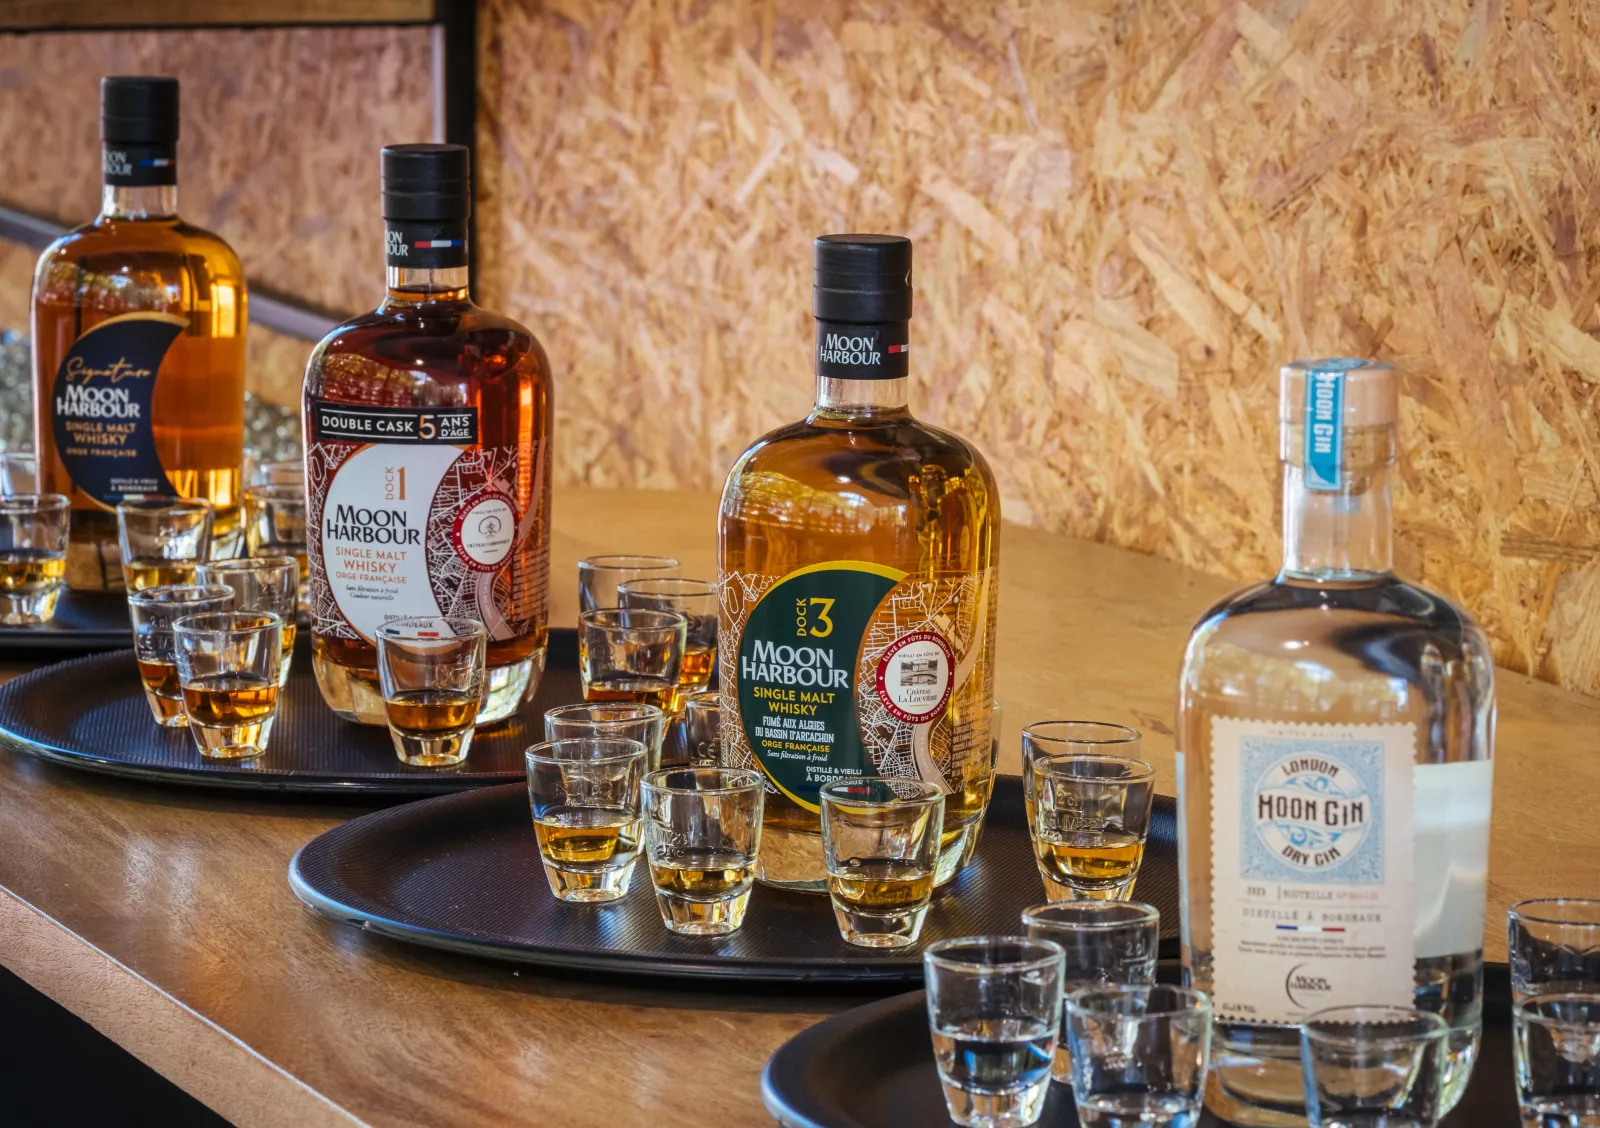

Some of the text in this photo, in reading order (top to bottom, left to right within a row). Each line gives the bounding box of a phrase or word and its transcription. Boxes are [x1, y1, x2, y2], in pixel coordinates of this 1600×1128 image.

[825, 333, 874, 352] MOON
[820, 345, 881, 365] HARBOUR
[66, 356, 152, 385] Signature
[66, 384, 129, 403] MOON
[57, 397, 141, 418] HARBOUR
[1313, 372, 1335, 454] MOON GIN
[65, 421, 137, 433] SINGLE MALT
[322, 415, 437, 440] DOUBLE CASK 5
[441, 417, 470, 427] ANS
[73, 433, 127, 446] WHISKY
[385, 466, 406, 500] DOCK 1
[336, 504, 407, 527] MOON
[327, 519, 421, 545] HARBOUR
[335, 547, 407, 560] SINGLE MALT
[343, 559, 397, 573] WHISKY
[336, 571, 407, 584] ORGE FRANÇAISE
[796, 597, 836, 638] DOCK 3
[752, 639, 834, 668] MOON
[883, 645, 898, 662] ÉLEVÉ
[907, 635, 922, 643] FÛTS
[742, 655, 849, 688] HARBOUR
[753, 687, 835, 704] SINGLE MALT
[768, 701, 817, 716] WHISKY
[880, 690, 894, 710] ÉLEVÉ
[893, 709, 902, 717] EN
[903, 713, 919, 722] FÛTS
[763, 715, 825, 731] FUMÉ AUX ALGUES
[755, 726, 834, 743] DU BASSIN D'ARCACHON
[761, 739, 830, 753] ORGE FRANÇAISE
[767, 749, 780, 758] Sans
[780, 750, 806, 761] filtration
[811, 754, 828, 762] froid
[806, 766, 833, 774] DISTILLÉ
[806, 772, 812, 782] À
[1281, 758, 1340, 778] LONDON
[1258, 794, 1363, 826] MOON GIN
[1281, 844, 1341, 866] DRY GIN
[1322, 913, 1382, 923] BORDEAUX
